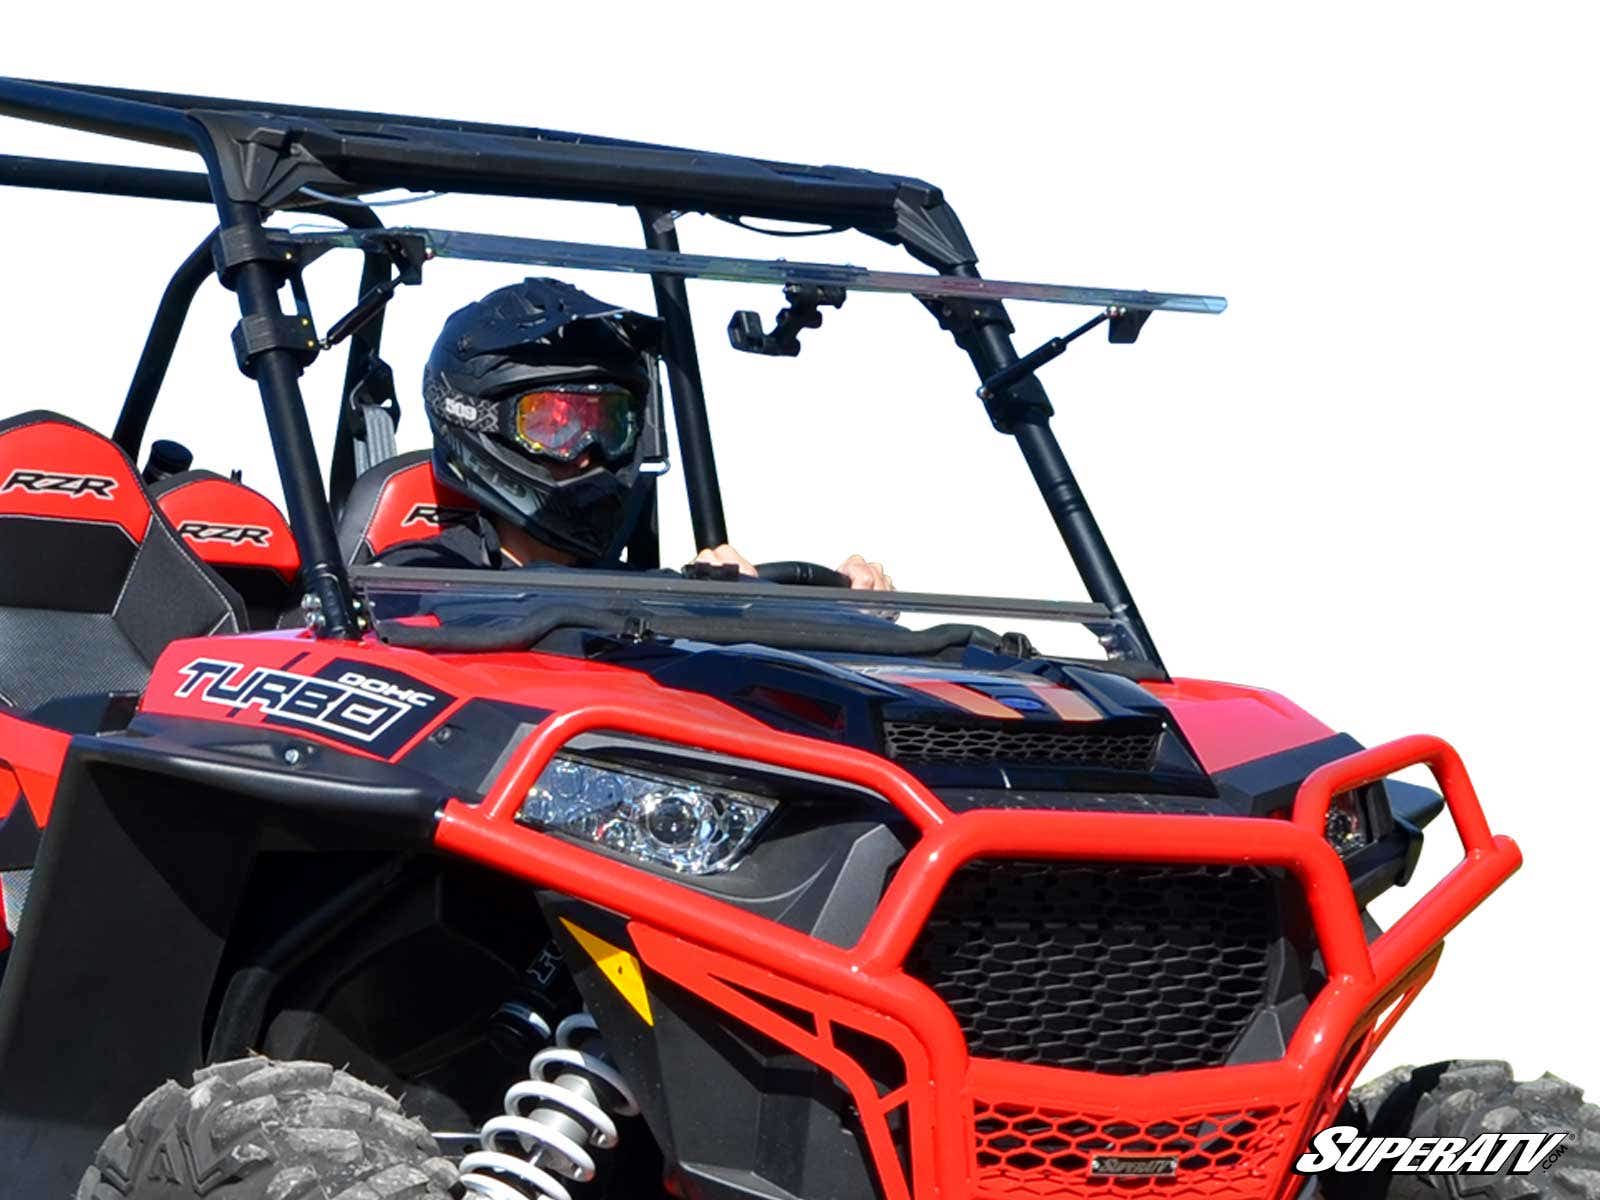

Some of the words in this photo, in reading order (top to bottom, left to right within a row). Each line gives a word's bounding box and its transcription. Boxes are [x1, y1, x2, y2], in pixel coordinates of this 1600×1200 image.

[2, 471, 118, 500] RZR
[178, 522, 273, 547] RZR
[175, 658, 411, 742] TURBO
[338, 672, 436, 708] DOHC
